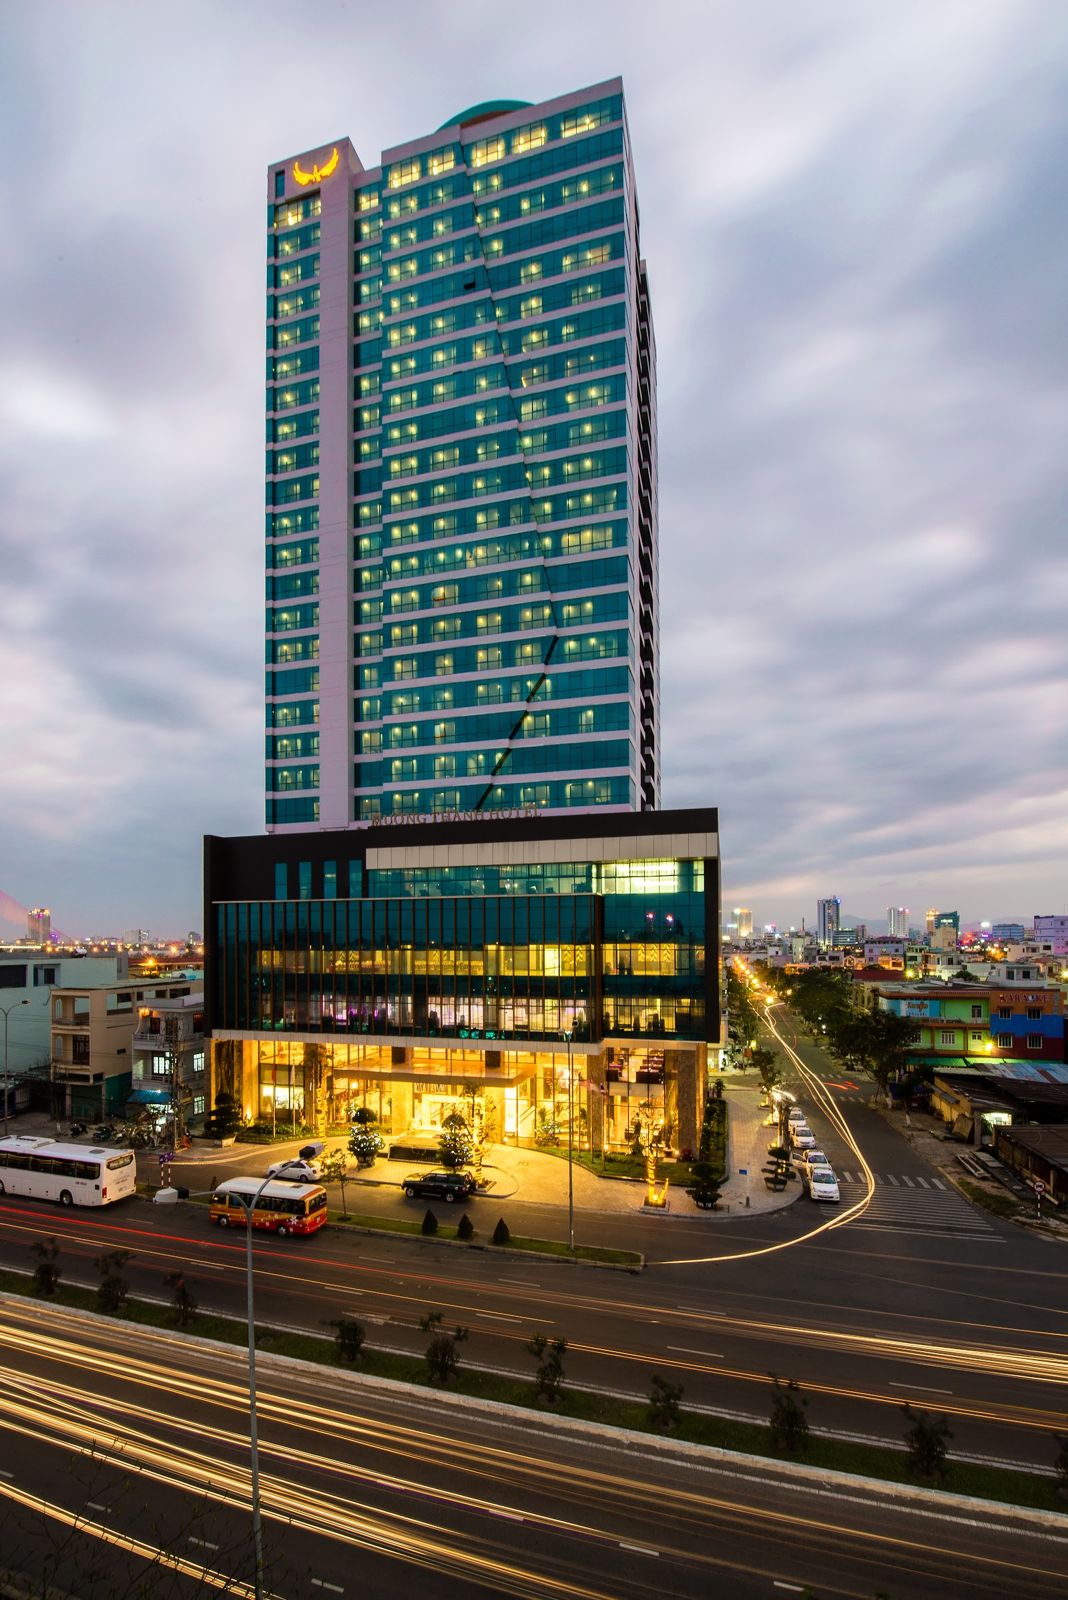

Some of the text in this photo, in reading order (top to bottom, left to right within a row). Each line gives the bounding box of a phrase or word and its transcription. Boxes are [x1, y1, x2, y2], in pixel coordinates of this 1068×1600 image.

[430, 808, 484, 823] THANH
[489, 805, 542, 820] HOTEL
[999, 993, 1049, 1003] KARAOKE
